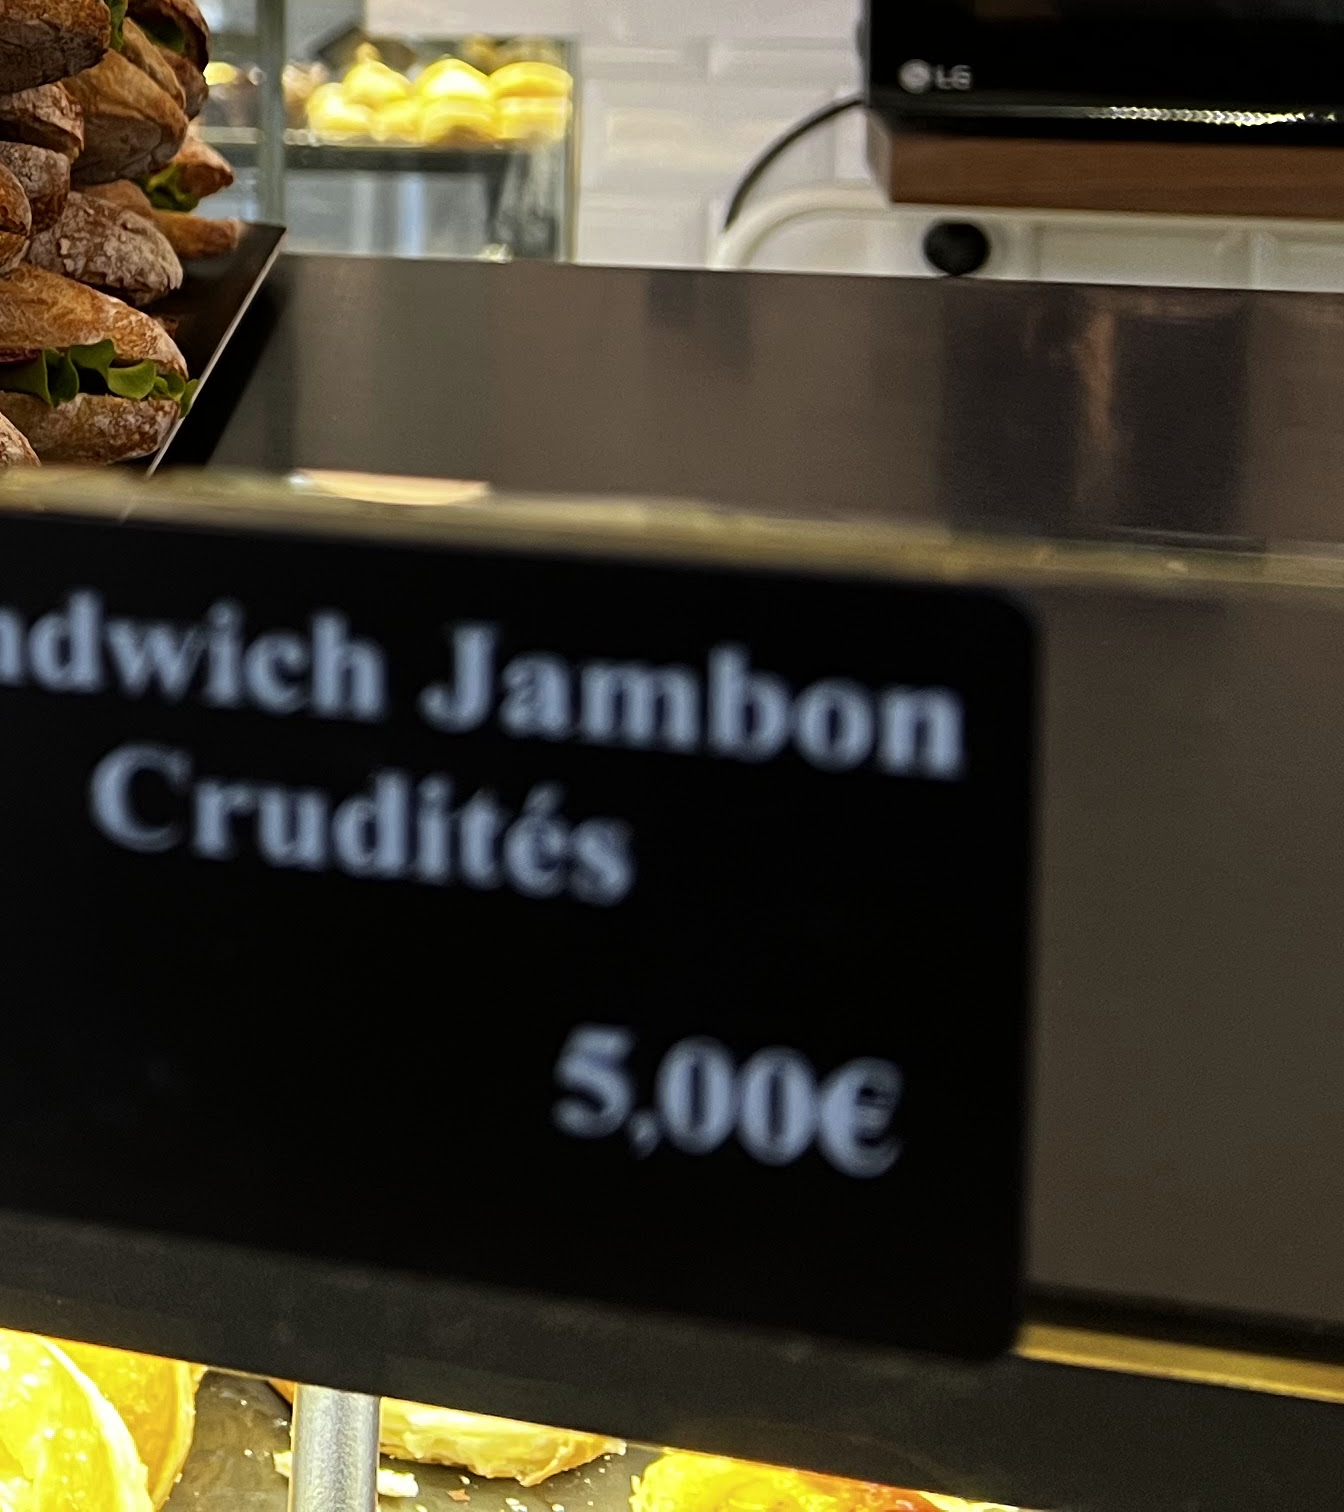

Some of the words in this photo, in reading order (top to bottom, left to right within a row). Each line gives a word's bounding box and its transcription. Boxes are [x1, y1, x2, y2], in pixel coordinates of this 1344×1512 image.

[934, 63, 972, 91] LG
[419, 620, 969, 782] Jambon
[88, 742, 634, 905] Crudités
[553, 1025, 902, 1180] 5,00€
